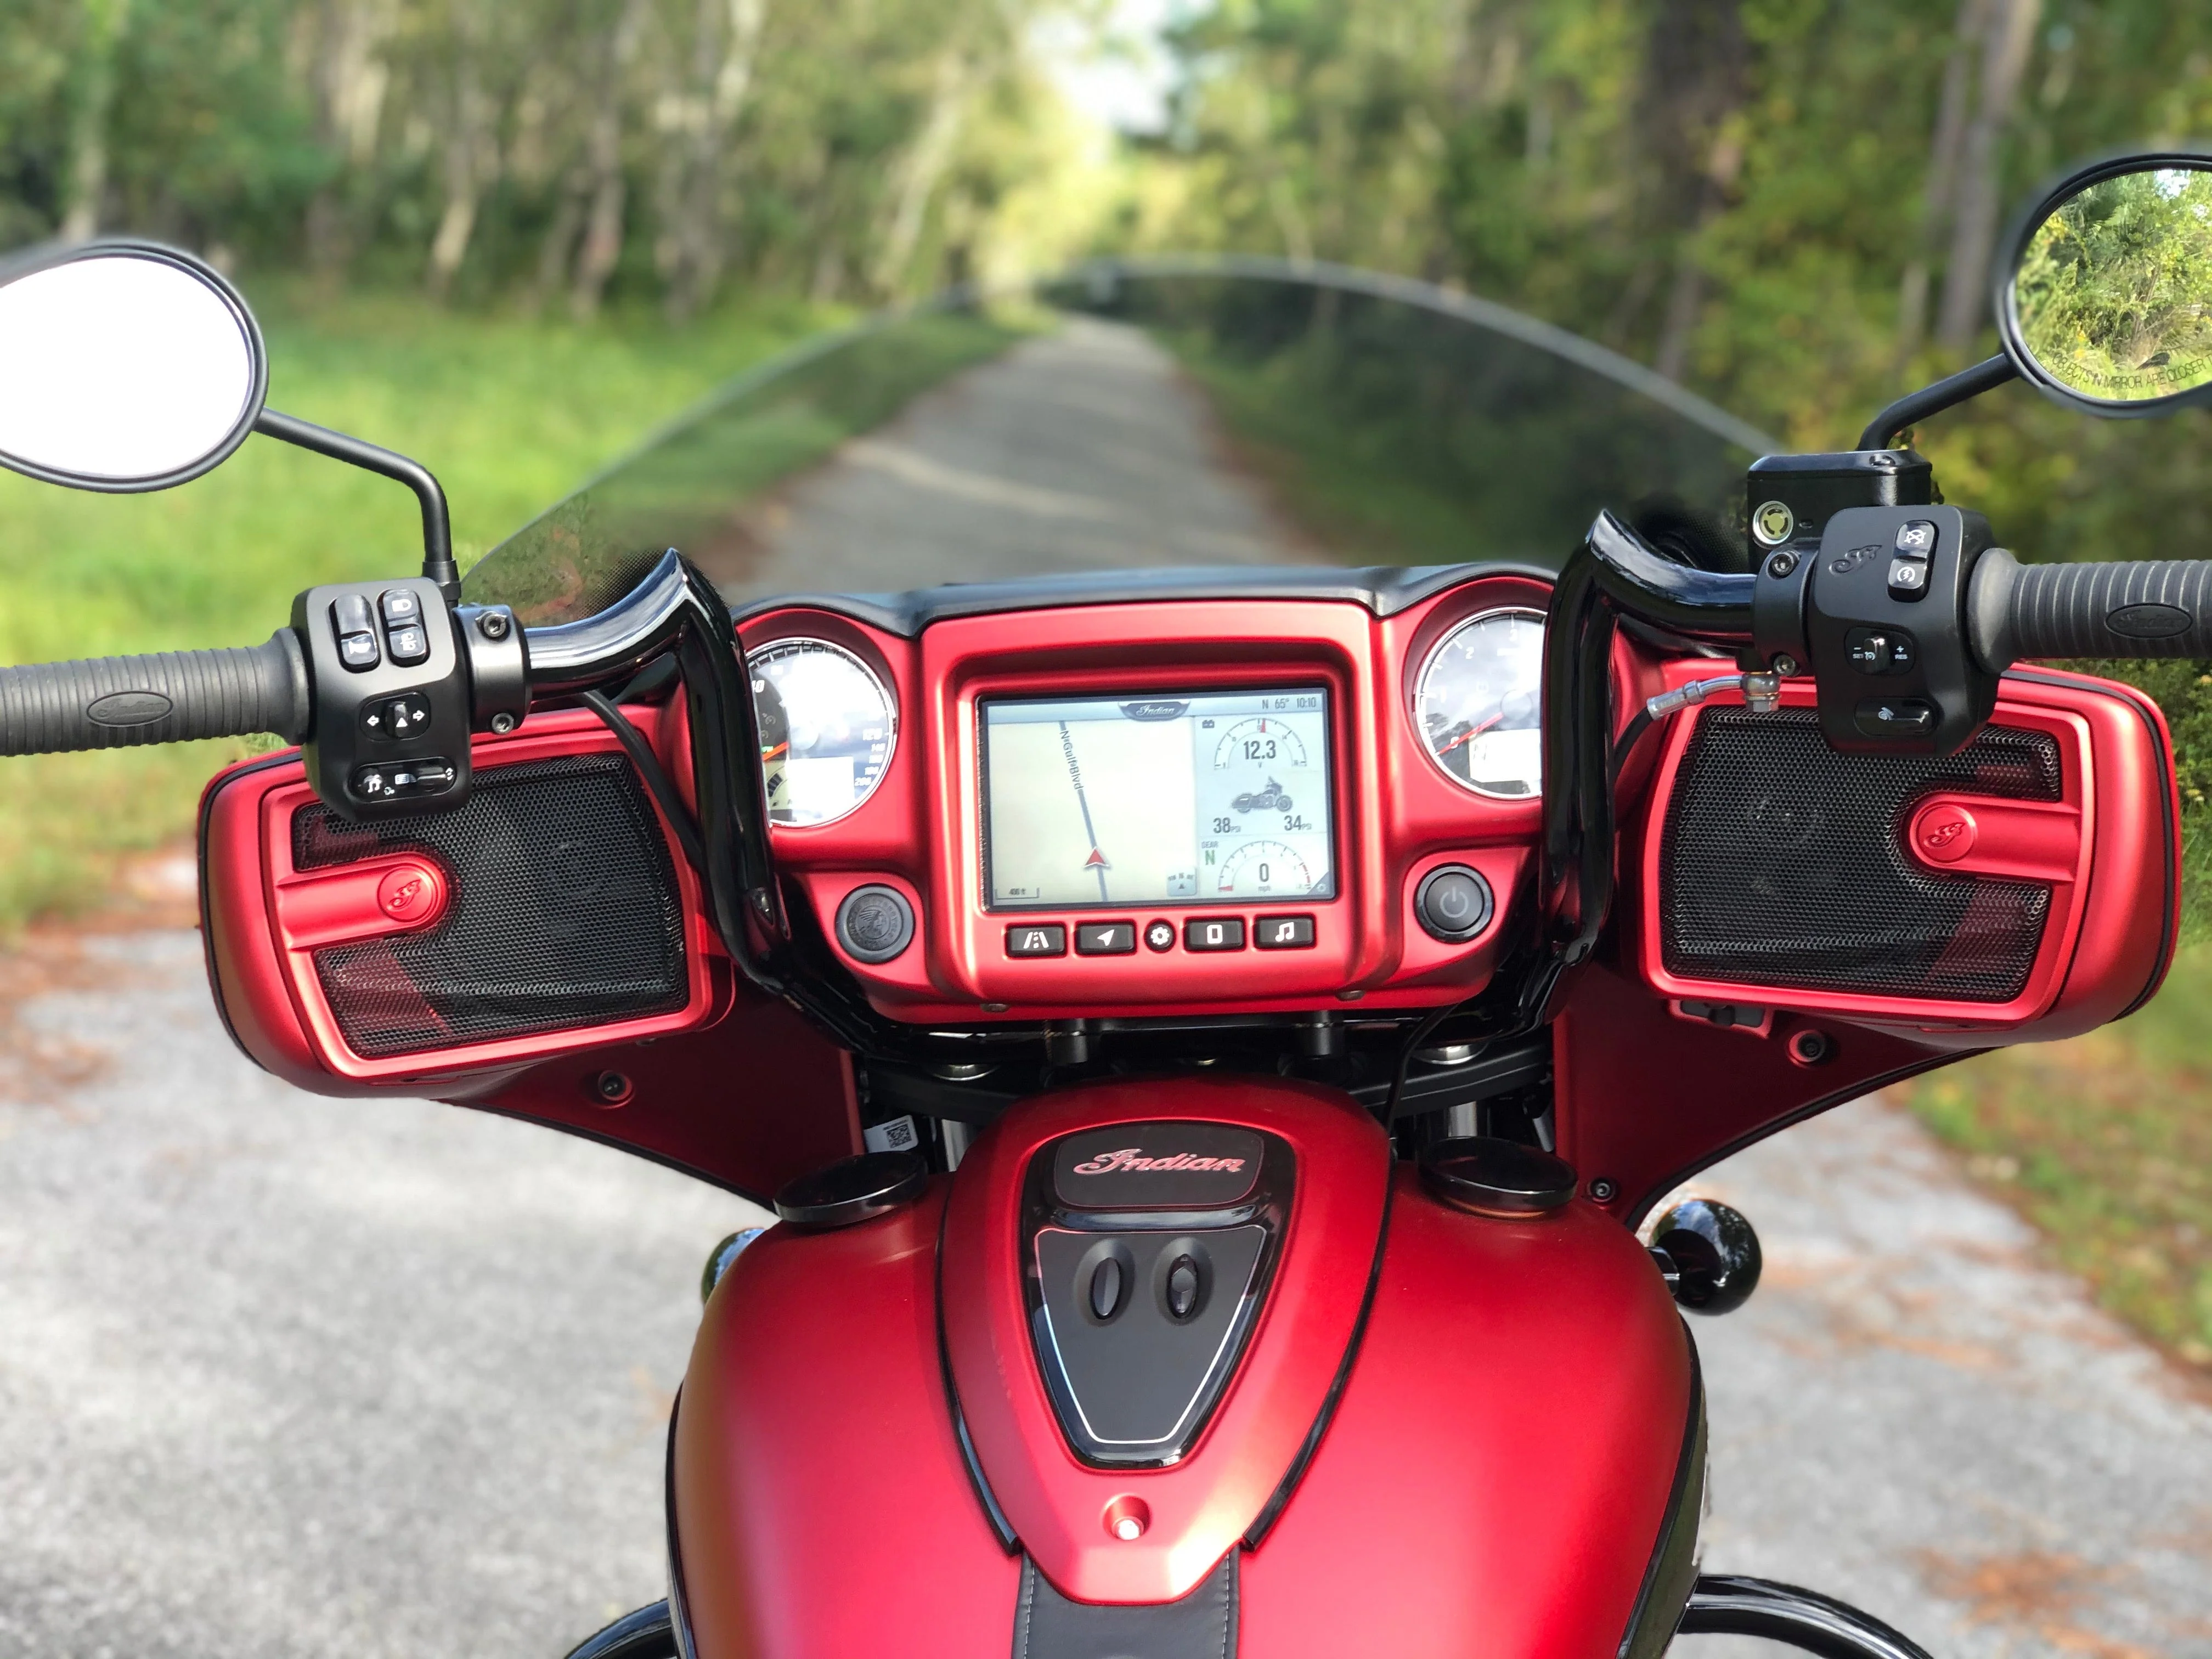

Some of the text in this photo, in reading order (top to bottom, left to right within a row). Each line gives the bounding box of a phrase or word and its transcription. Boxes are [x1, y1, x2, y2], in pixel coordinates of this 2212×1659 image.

[2052, 353, 2093, 383] OBJECTS
[2092, 373, 2101, 387] IN
[2103, 375, 2143, 389] MIRROR
[2146, 372, 2168, 386] ARE
[2167, 358, 2207, 382] CLOSER
[1465, 647, 1474, 659] 2
[1136, 704, 1175, 716] Indian
[1262, 699, 1269, 709] N
[1297, 697, 1317, 708] 10:10
[1063, 742, 1077, 764] Gulf
[1243, 740, 1277, 760] 12.3
[1069, 766, 1084, 790] Blvd
[1213, 817, 1231, 833] 38
[1284, 815, 1301, 831] 34
[1205, 850, 1216, 866] N
[1259, 863, 1269, 882] 0
[1073, 1148, 1246, 1175] Indian
